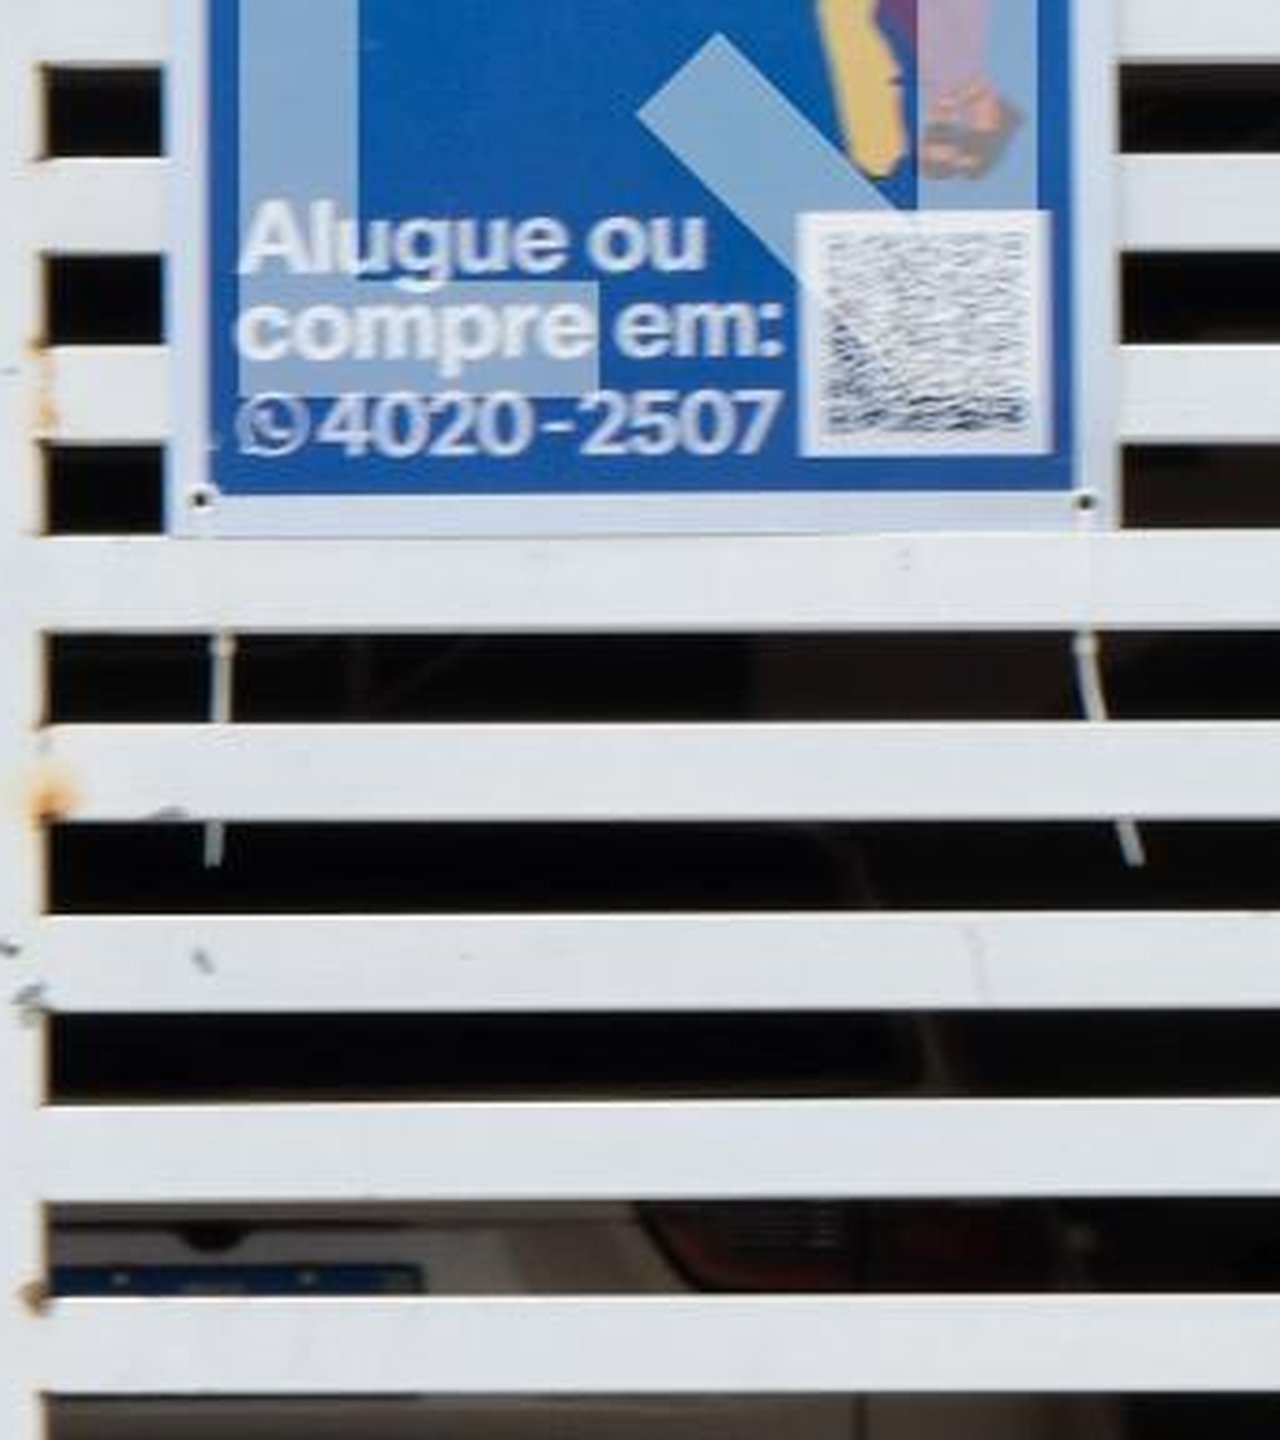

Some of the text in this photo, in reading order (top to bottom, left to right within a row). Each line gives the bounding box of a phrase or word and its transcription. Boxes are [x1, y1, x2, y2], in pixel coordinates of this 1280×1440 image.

[237, 198, 705, 290] Alugue ou
[236, 296, 785, 376] compre em:
[321, 387, 786, 459] 4020-2507
